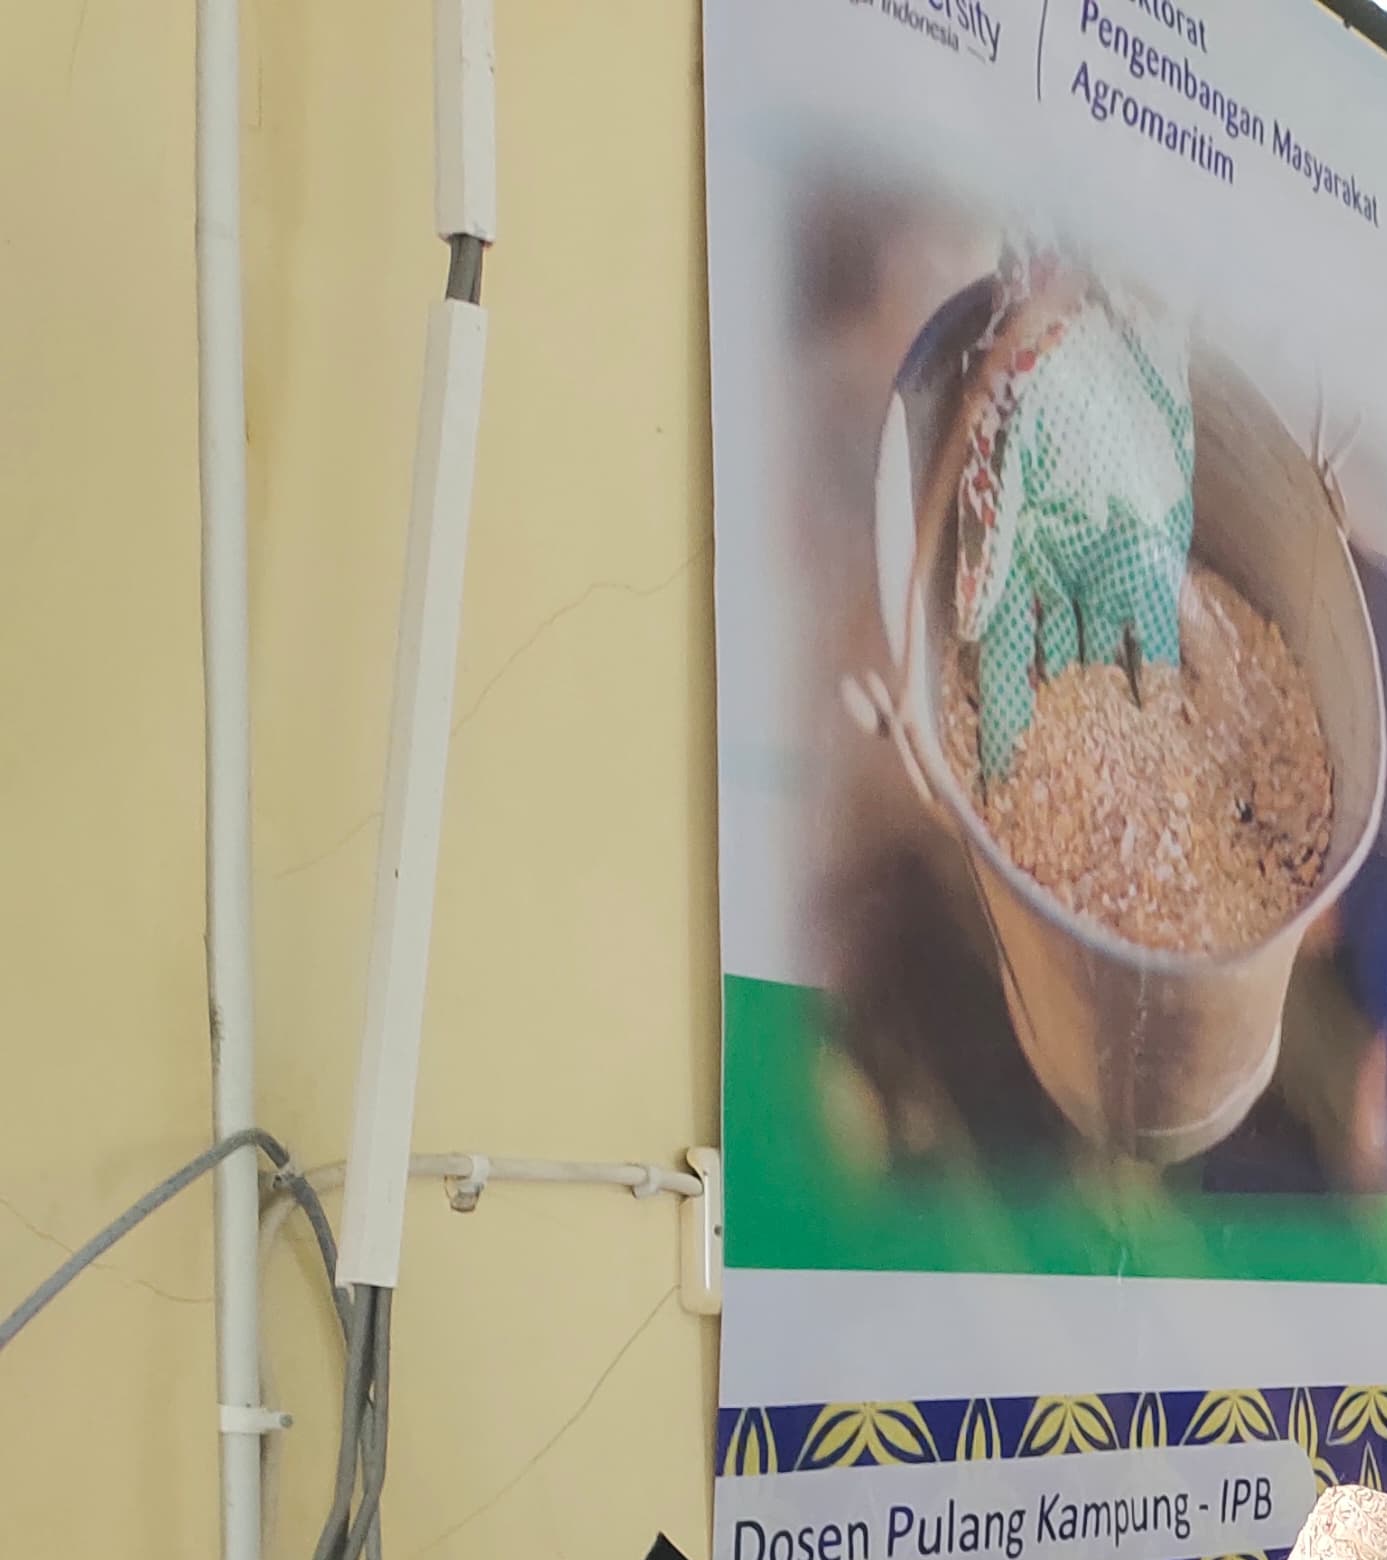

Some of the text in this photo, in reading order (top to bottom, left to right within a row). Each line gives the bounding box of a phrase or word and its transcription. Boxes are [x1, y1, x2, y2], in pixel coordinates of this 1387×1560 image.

[929, 0, 1001, 63] rsity
[1071, 60, 1235, 185] Agromaritim
[1080, 0, 1380, 228] Pengembangan Masyarakat
[887, 1499, 1025, 1559] Pulang
[1037, 1491, 1191, 1547] Kampung
[1221, 1477, 1274, 1523] IPB
